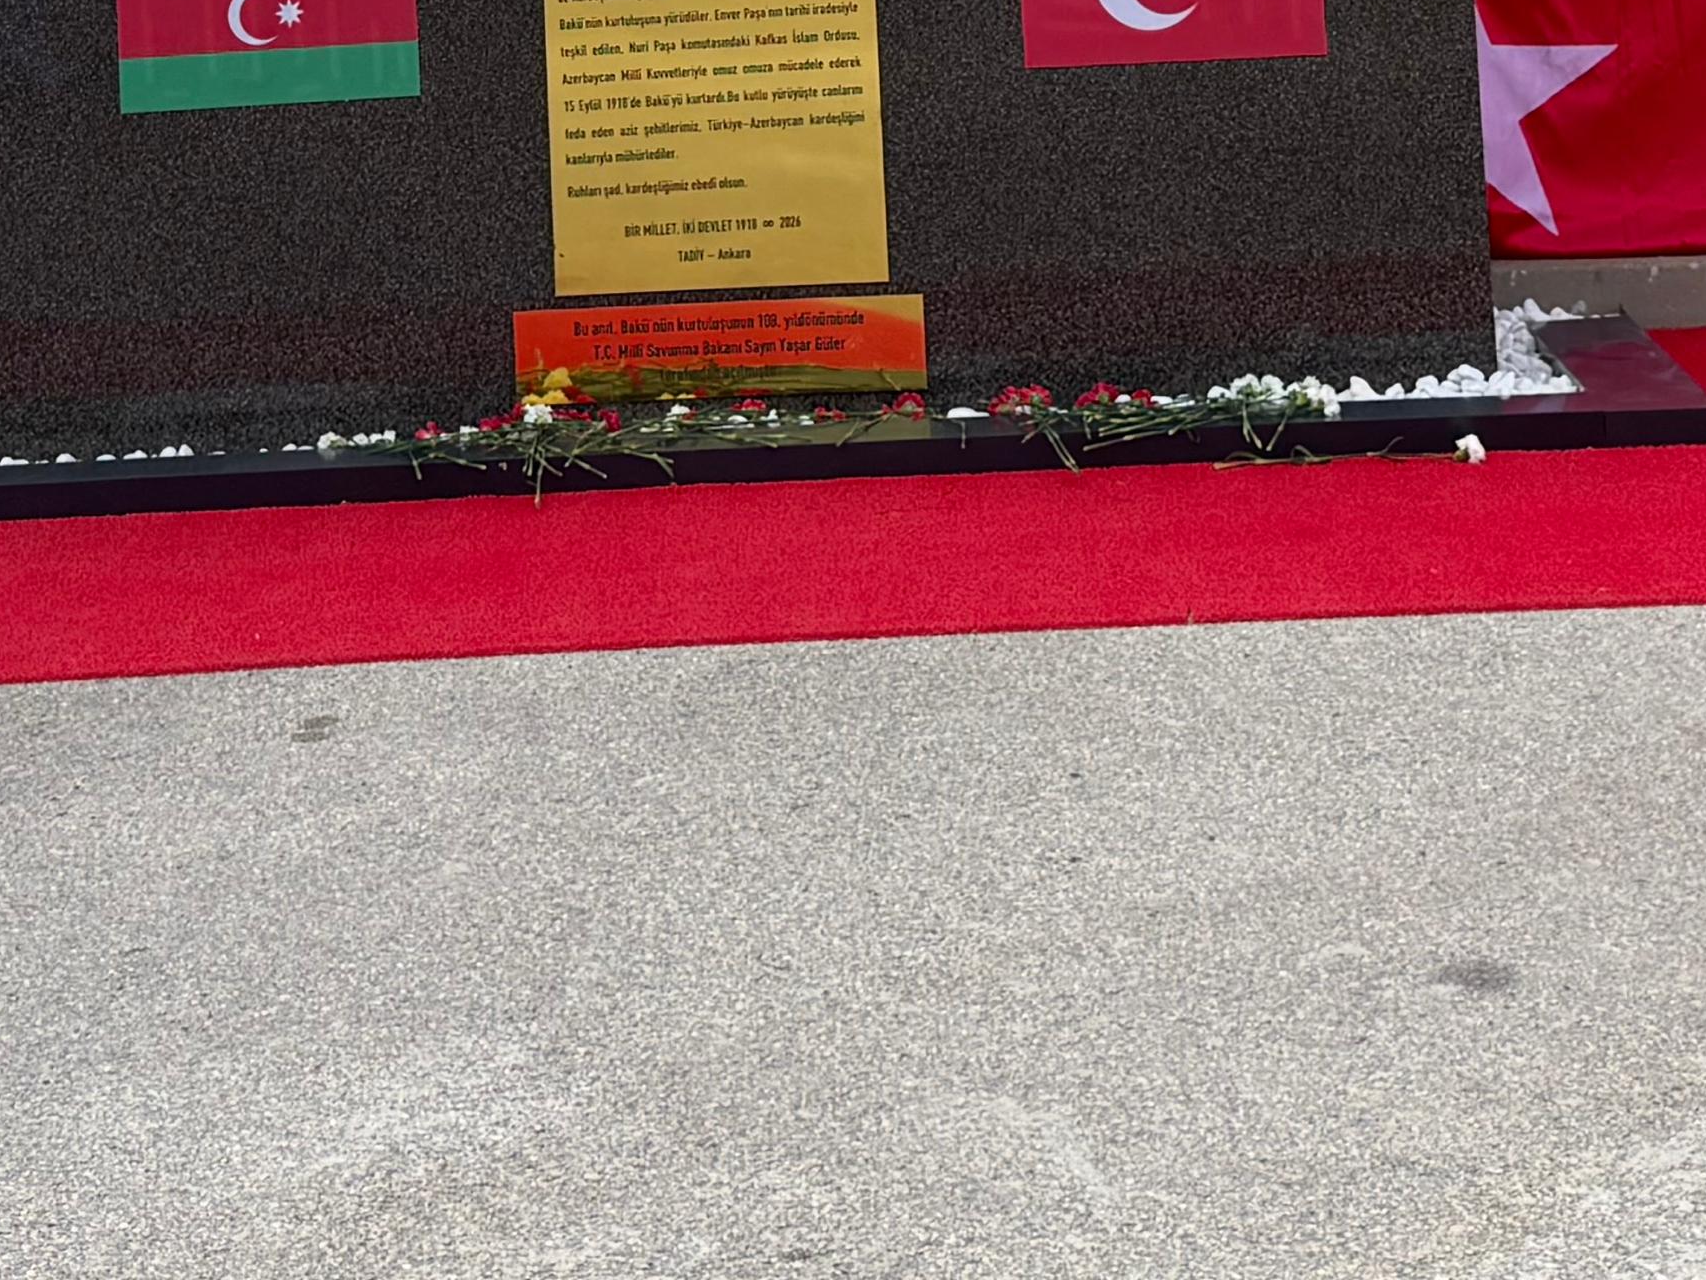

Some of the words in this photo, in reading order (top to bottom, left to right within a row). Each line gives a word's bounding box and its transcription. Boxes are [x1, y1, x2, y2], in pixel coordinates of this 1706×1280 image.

[714, 9, 740, 21] Enver
[560, 45, 587, 60] teşkil
[629, 41, 649, 53] Nuri
[654, 40, 676, 54] Paşa
[755, 33, 787, 46] Kafkas
[793, 29, 818, 43] İslam
[562, 72, 615, 85] Azerbaycan
[713, 66, 737, 76] omuz
[743, 64, 773, 74] omuza
[778, 58, 824, 71] mücadele
[829, 56, 861, 68] ederek
[564, 100, 575, 112] 15
[579, 99, 602, 114] Eylül
[743, 89, 768, 101] kutlu
[565, 128, 586, 139] feda
[591, 127, 614, 138] eden
[620, 124, 638, 136] aziz
[624, 224, 641, 237] BİR
[698, 219, 732, 233] DEVLET
[736, 218, 757, 230] 1918
[718, 248, 751, 260] Ankara
[574, 321, 589, 336] Bu
[647, 344, 700, 359] Savunma
[703, 340, 742, 356] Bakanı
[744, 339, 776, 356] Sayın
[780, 338, 811, 355] Yaşar
